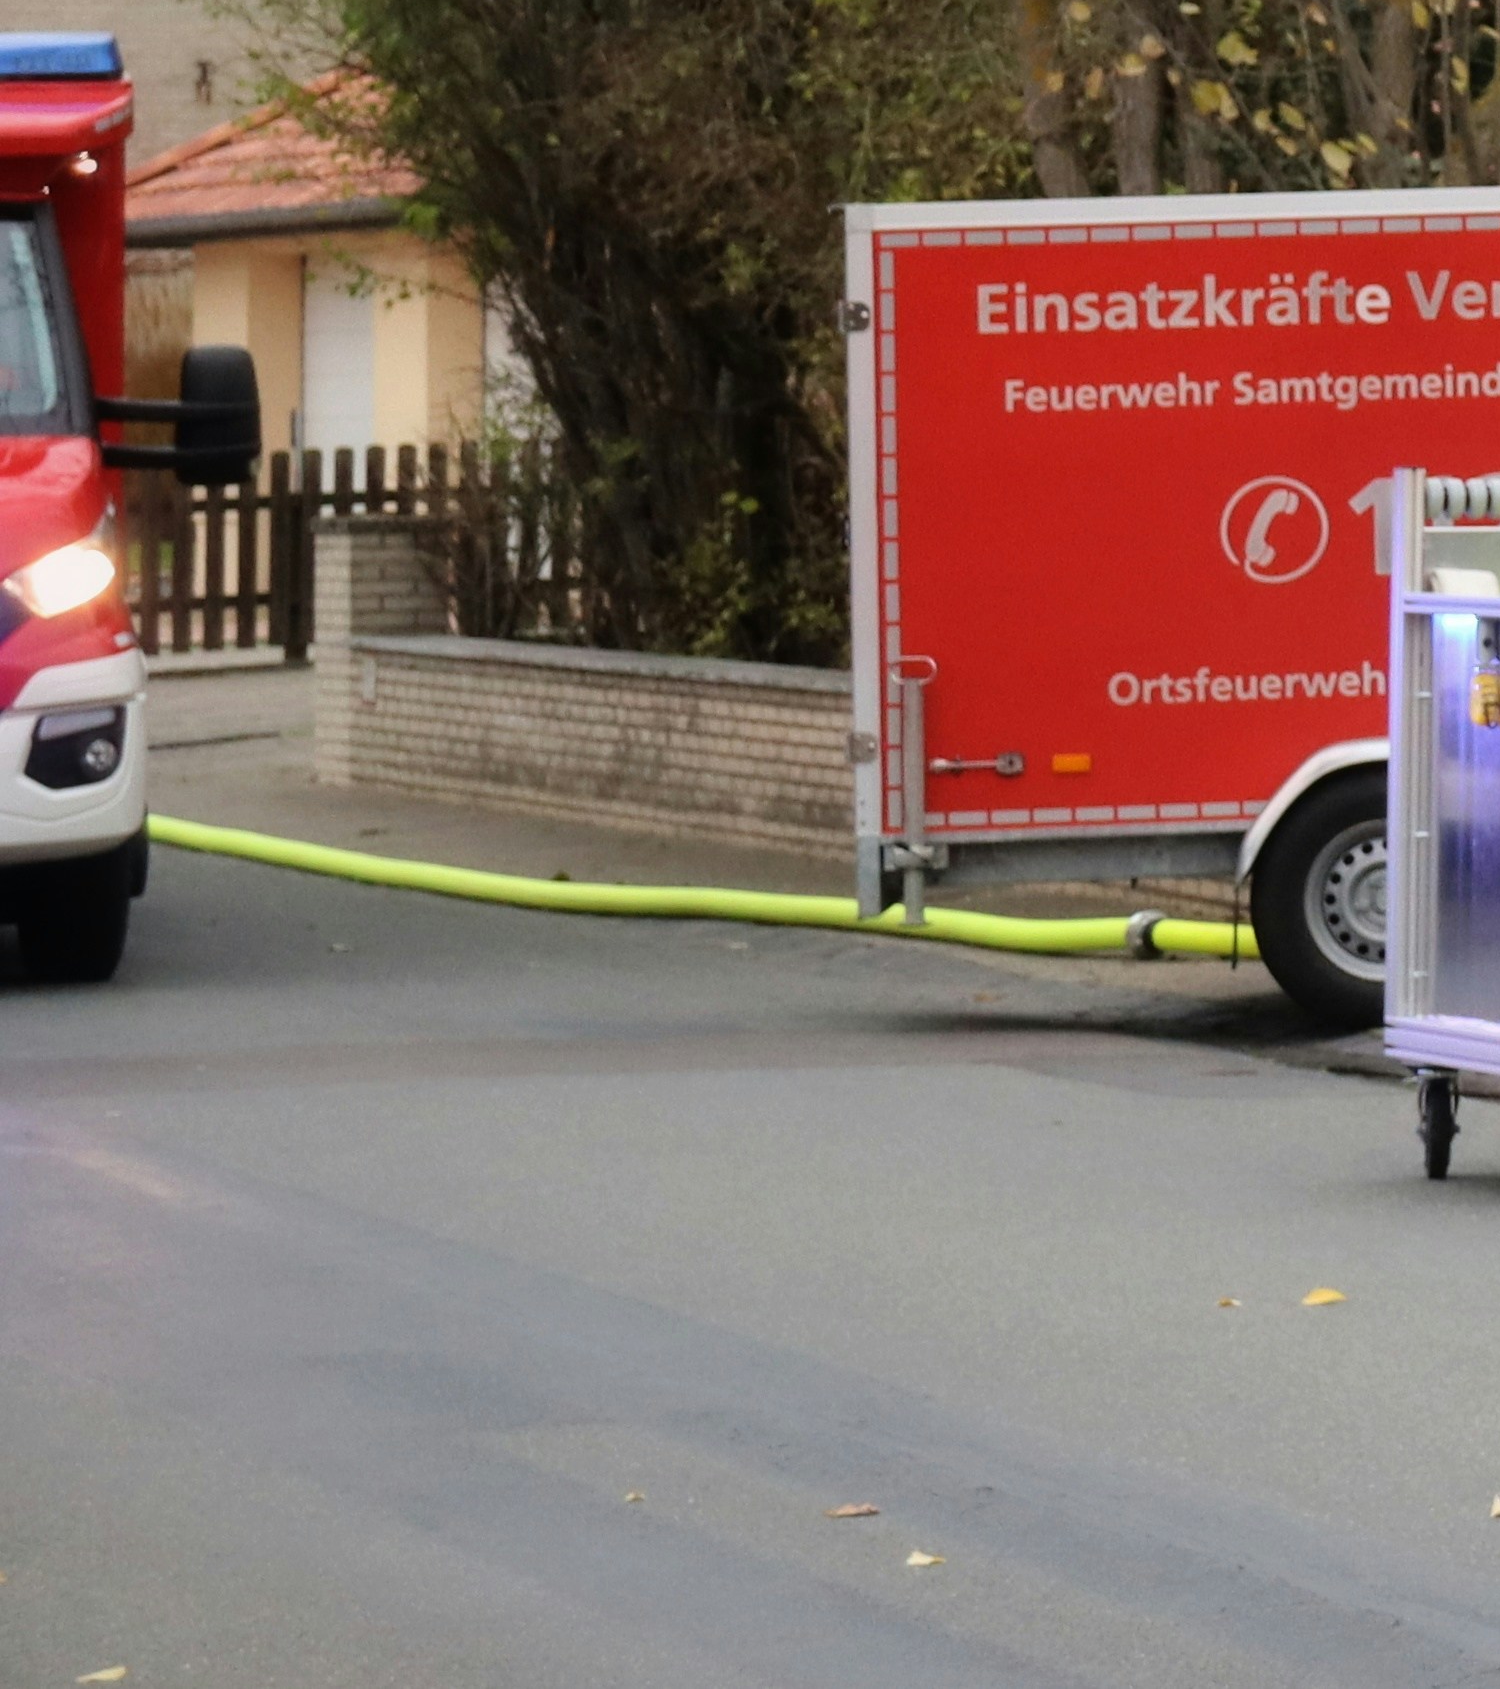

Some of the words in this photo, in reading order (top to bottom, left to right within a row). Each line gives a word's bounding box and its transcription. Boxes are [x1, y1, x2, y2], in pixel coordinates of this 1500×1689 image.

[976, 271, 1392, 335] Einsatzkräfte
[1003, 372, 1221, 413] Feuerwehr
[1108, 660, 1387, 707] Ortsfeuerweh
